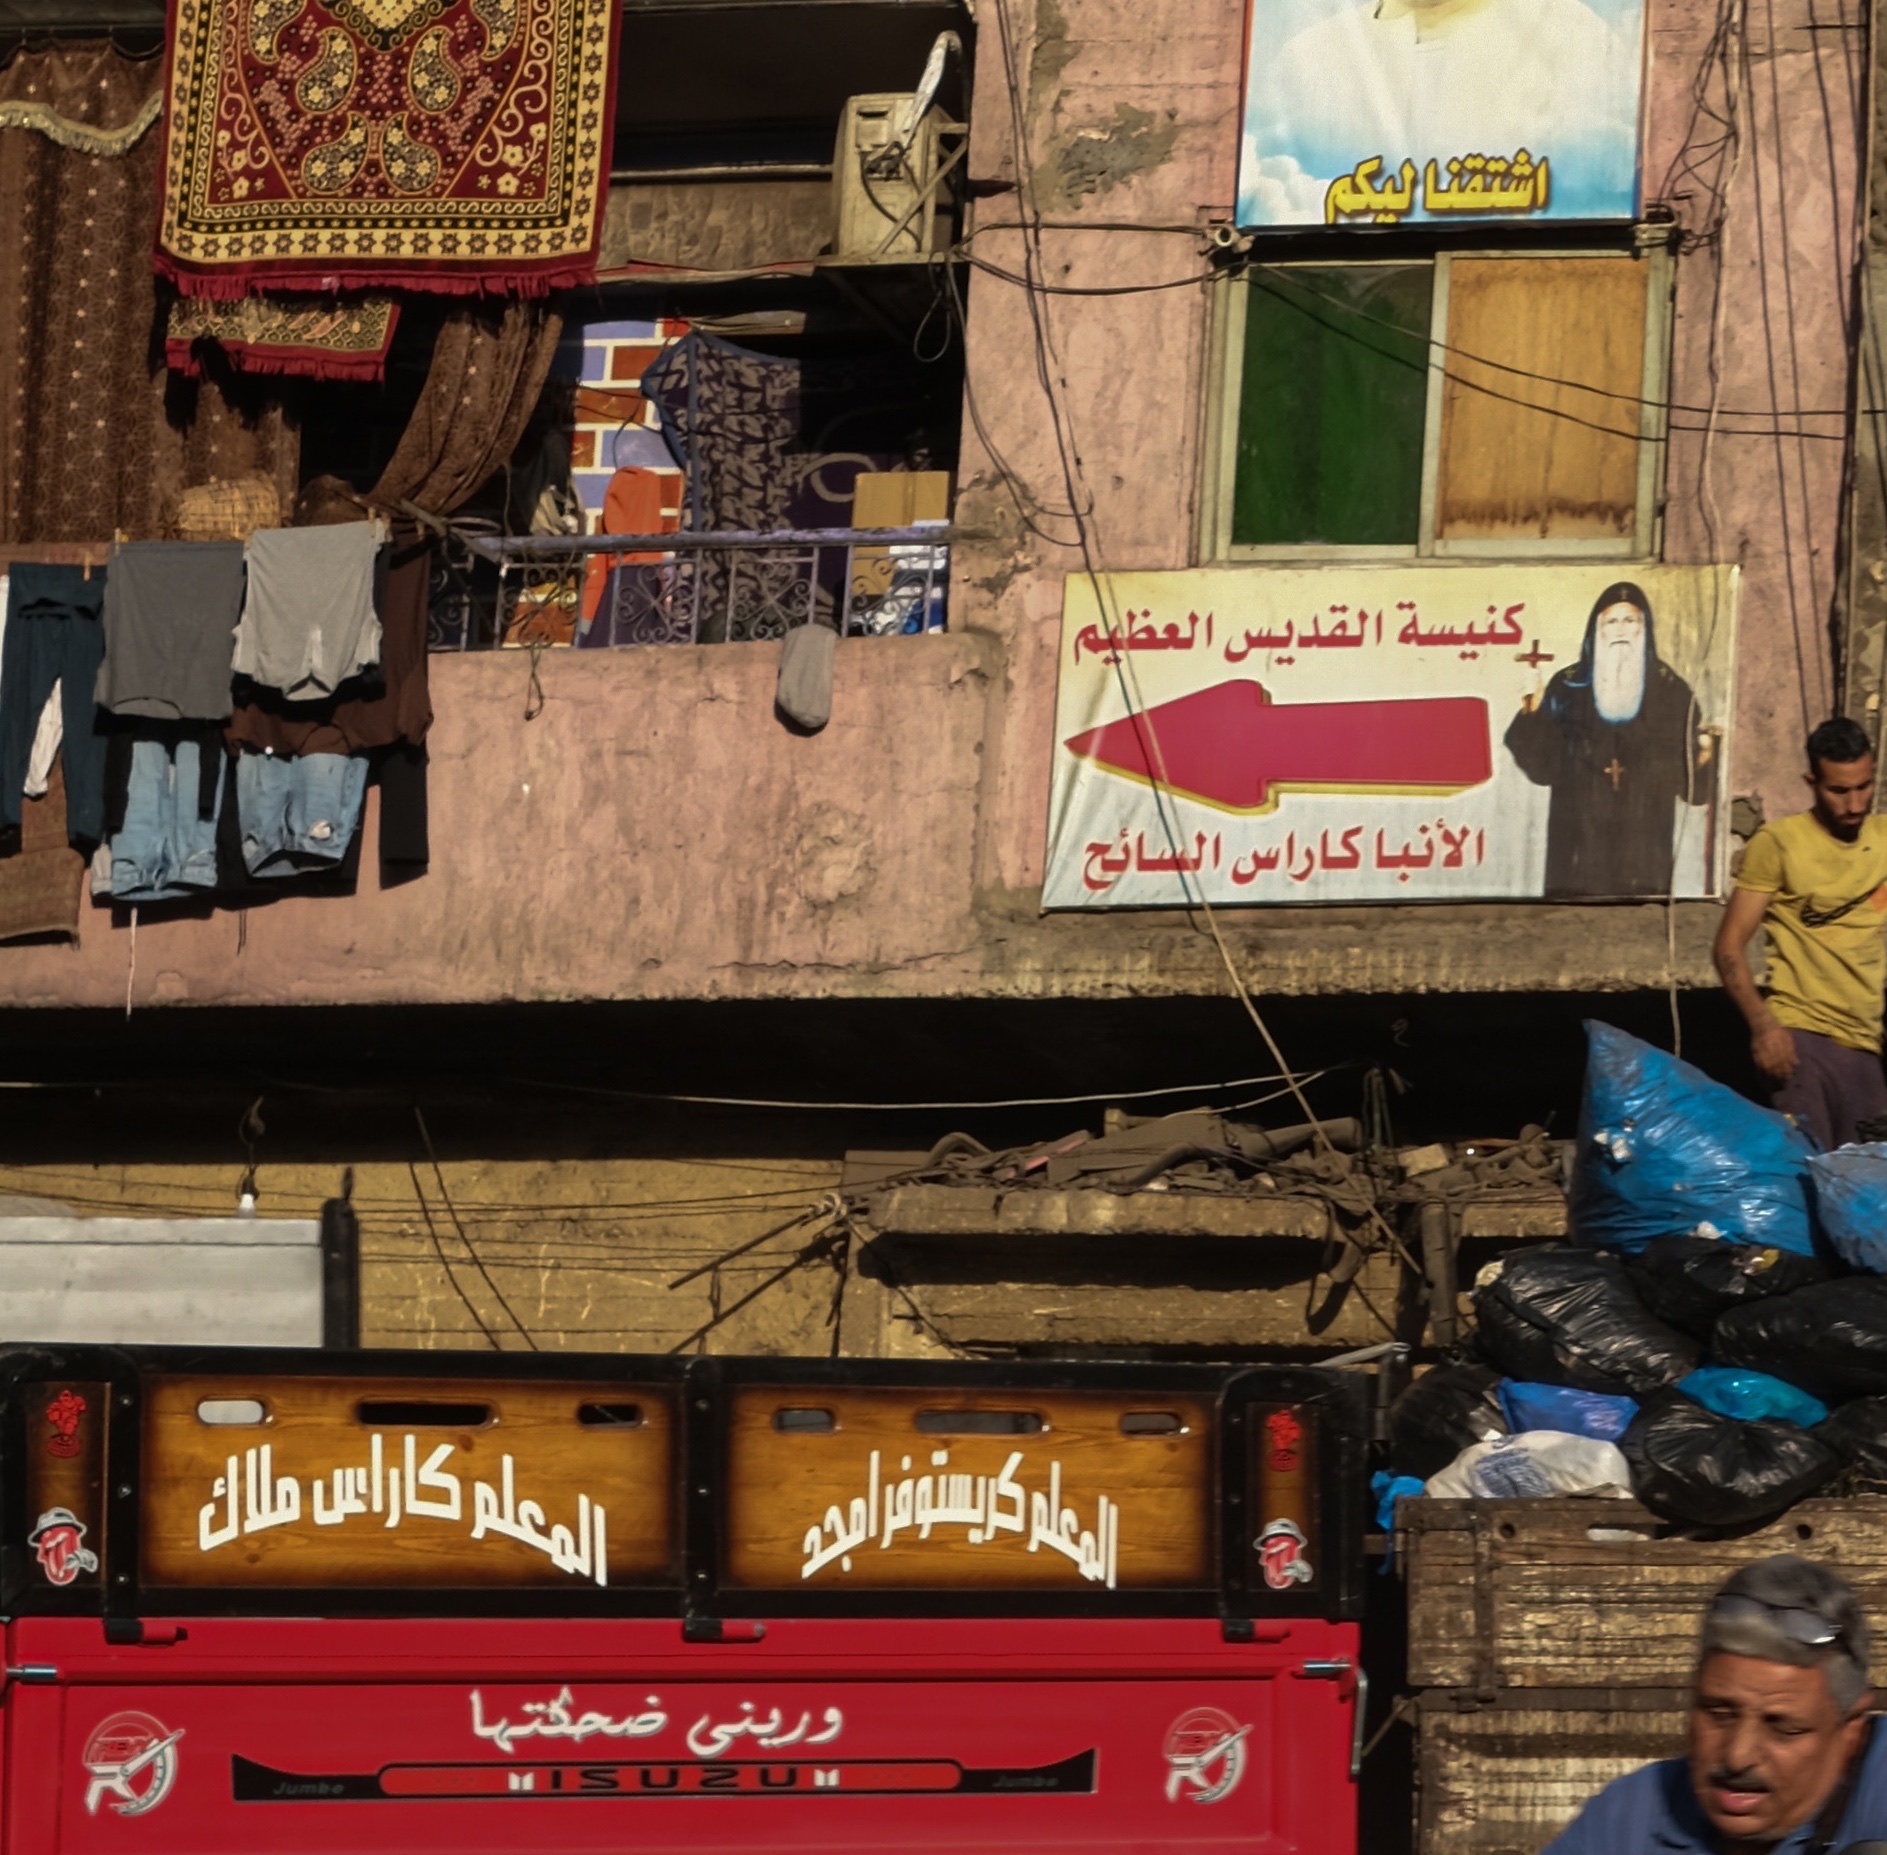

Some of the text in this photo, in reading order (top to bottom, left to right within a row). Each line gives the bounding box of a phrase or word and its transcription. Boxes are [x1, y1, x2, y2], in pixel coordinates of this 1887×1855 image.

[1325, 148, 1551, 224] اشتقنا ليكم
[1073, 600, 1525, 666] كنيسة القديس العظيم
[1082, 817, 1485, 891] الأنبا كاراس السائح
[199, 1433, 608, 1586] المعلم كاراس ملاك
[801, 1449, 1118, 1590] المعلم كريستوفر امجد
[469, 1684, 668, 1754] ضحكتها
[551, 1768, 798, 1790] ISUZU
